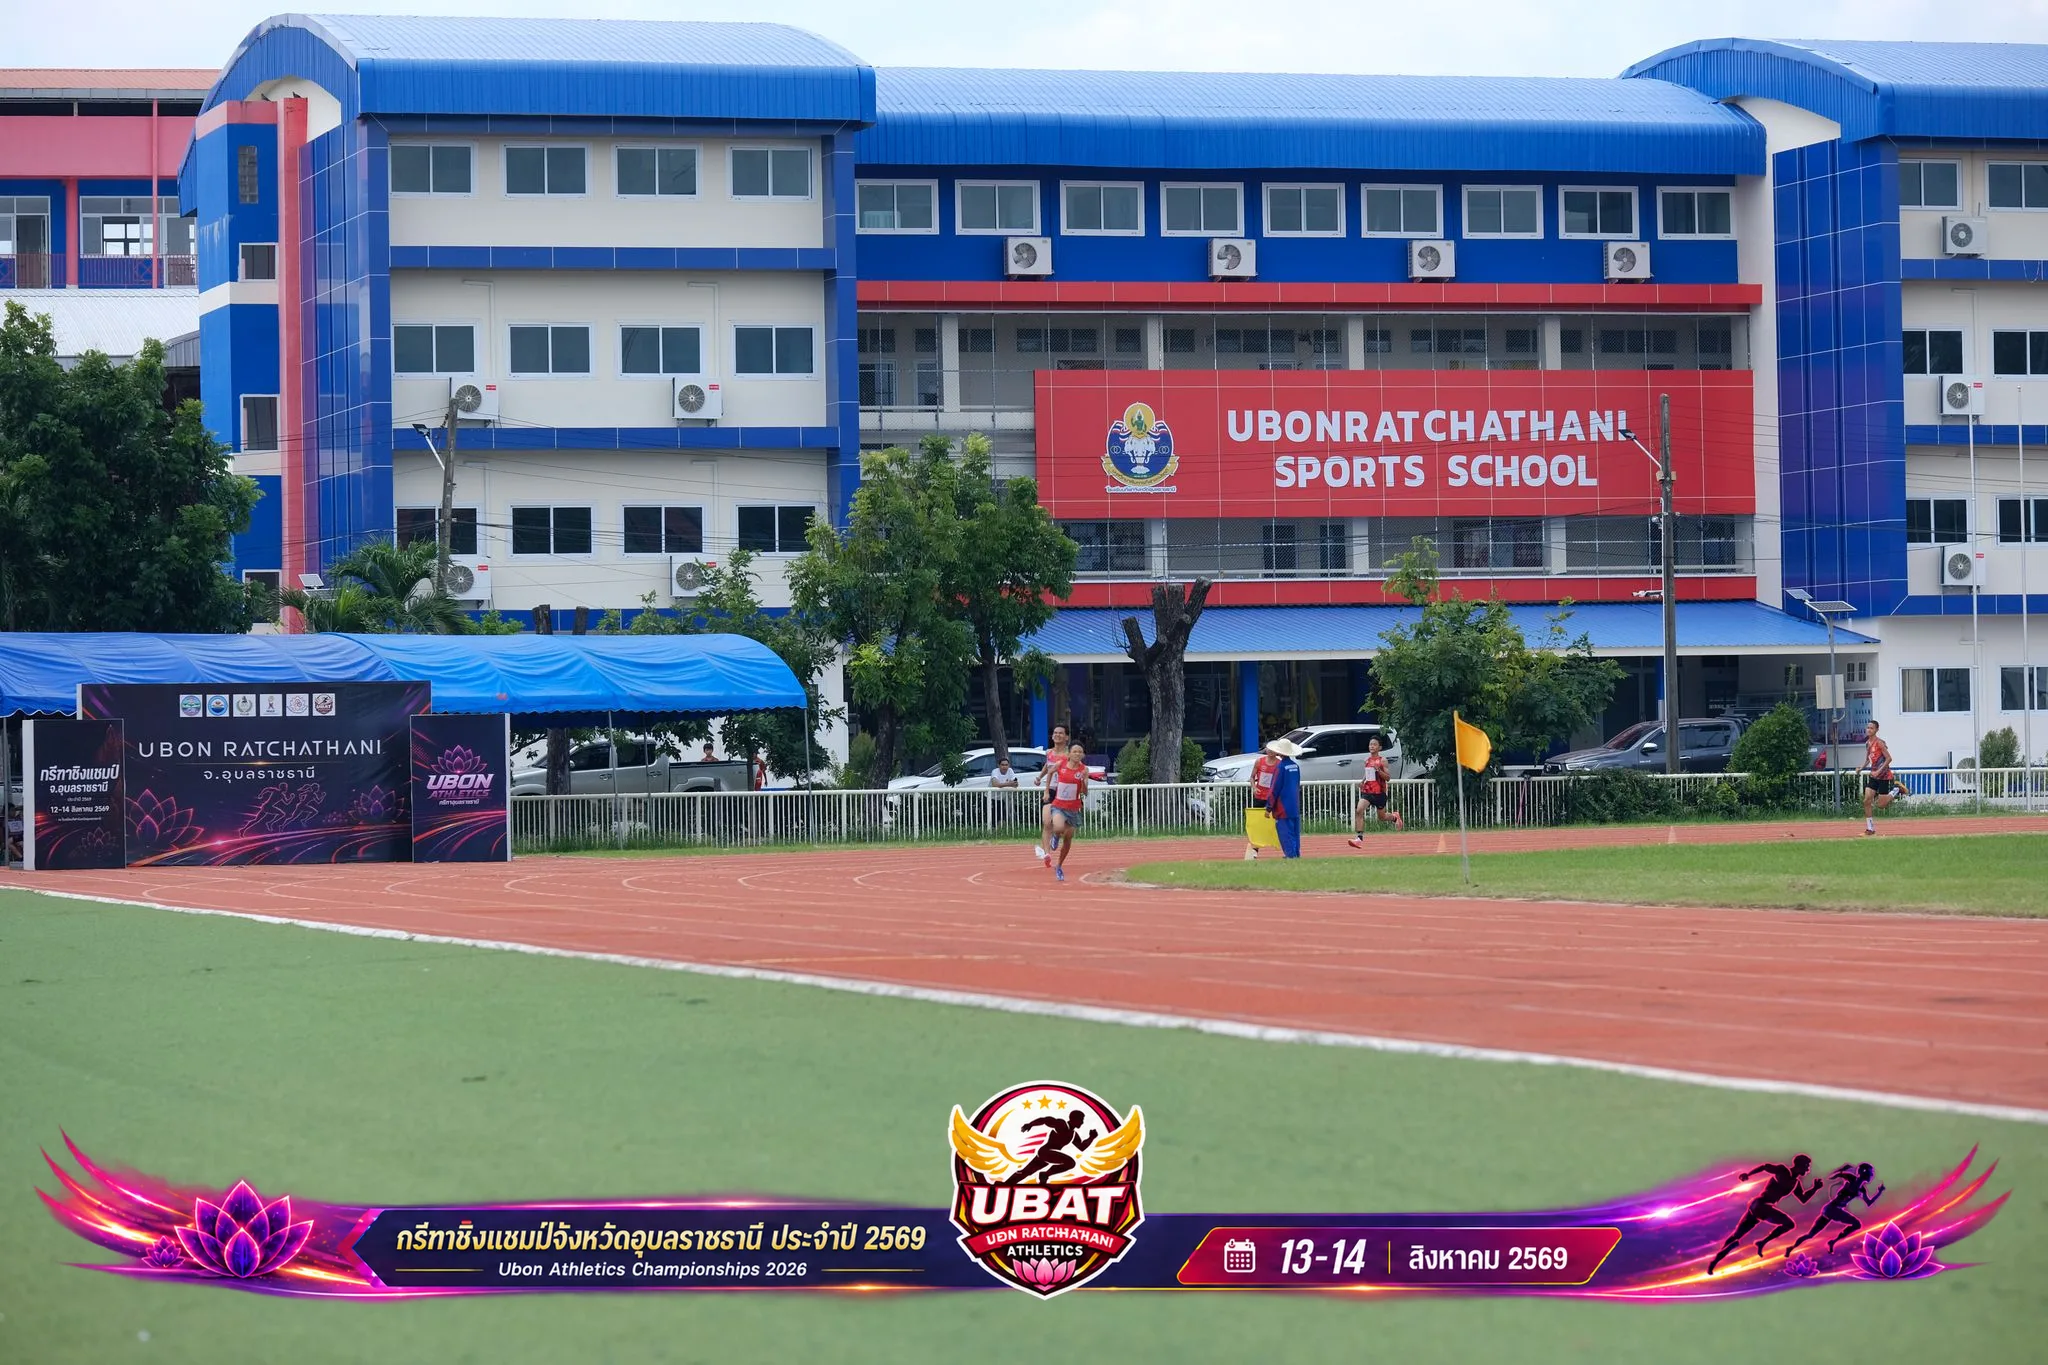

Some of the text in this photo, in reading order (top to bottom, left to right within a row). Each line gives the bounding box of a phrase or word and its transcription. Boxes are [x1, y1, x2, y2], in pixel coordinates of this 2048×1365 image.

[1227, 409, 1627, 442] UBONRATCHATHANI
[1274, 454, 1598, 488] SPORTS SCHOOL
[138, 739, 381, 758] UBON RATCHATHANI
[40, 764, 120, 781] กรีฑาชิงแชมป์
[203, 766, 315, 783] จ.อุบลราชธานี
[49, 781, 109, 796] จ.อุบลราชธานี
[426, 773, 495, 790] UBON
[427, 789, 492, 799] ATHLETICS
